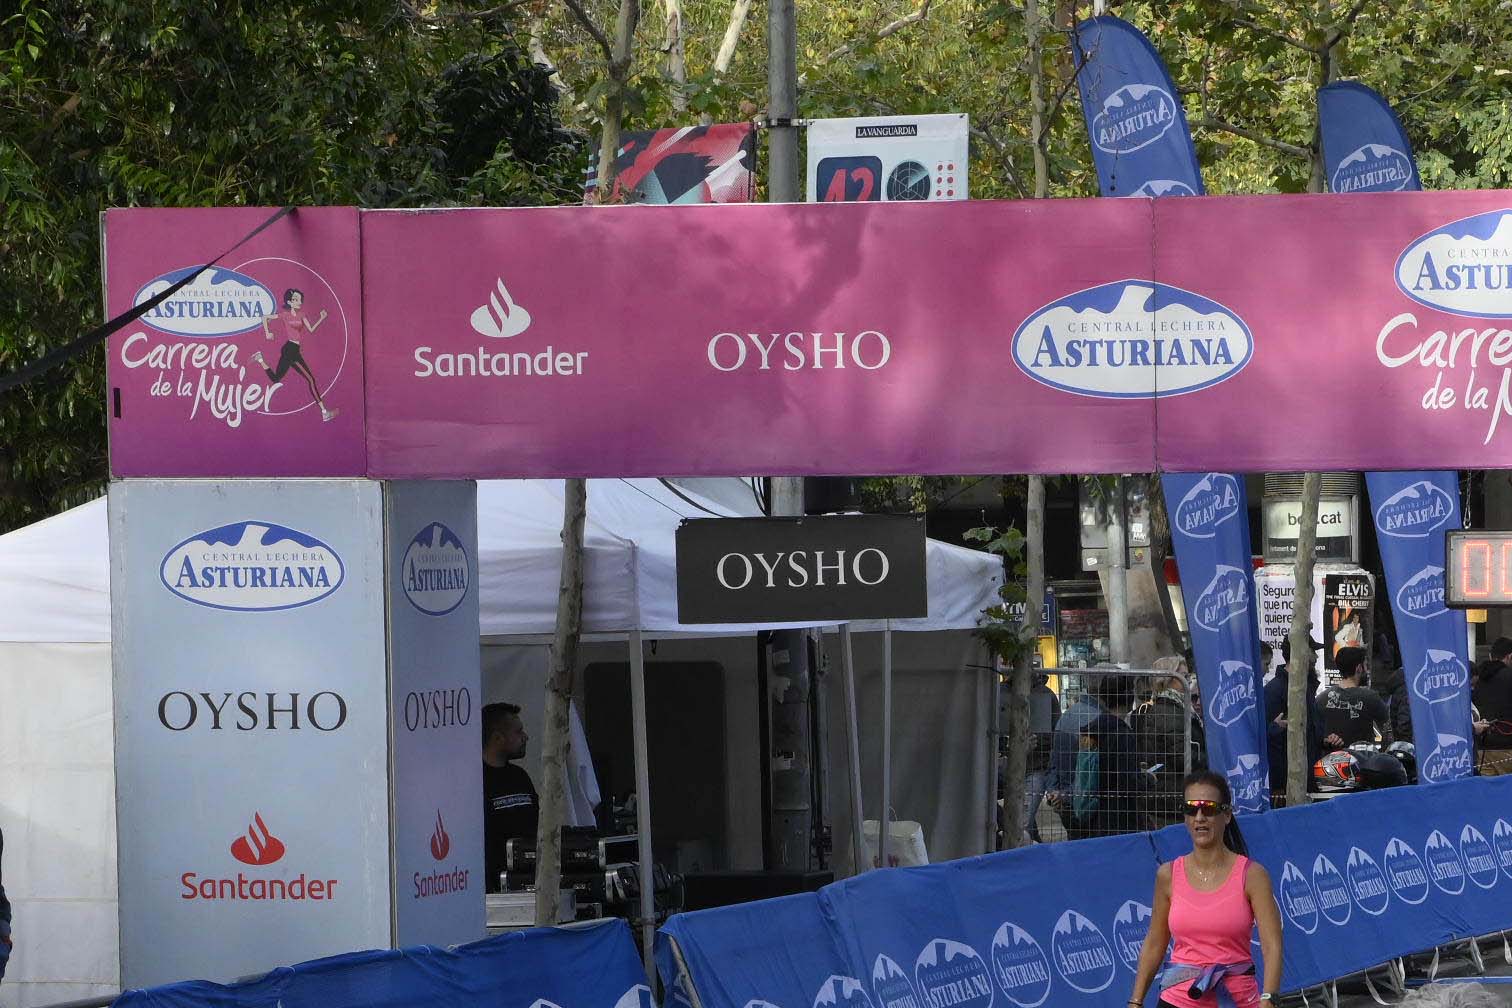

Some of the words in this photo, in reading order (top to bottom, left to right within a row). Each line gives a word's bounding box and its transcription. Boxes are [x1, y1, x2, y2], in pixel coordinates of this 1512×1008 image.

[866, 126, 917, 137] VANGUARDIA
[144, 292, 265, 319] ASTURIANA
[172, 289, 209, 298] ENTRAL
[214, 289, 260, 298] LECHERA
[1068, 321, 1143, 333] CENTRAL
[1151, 320, 1226, 332] LECHERA
[121, 331, 239, 370] Carrera
[413, 346, 589, 378] Santander
[706, 331, 893, 371] OYSHO
[1030, 324, 1235, 368] ASTURIANA
[150, 371, 172, 397] de
[177, 370, 193, 397] la
[190, 366, 284, 428] Mujer
[1421, 371, 1456, 410] de
[1464, 370, 1489, 410] la
[1288, 511, 1342, 526] b.cat
[175, 555, 332, 589] ASTURIANA
[202, 553, 260, 562] CENTRAL
[266, 552, 325, 562] LECHERA
[716, 547, 890, 590] OYSHO
[407, 555, 466, 593] ASTURIANA
[1338, 583, 1370, 596] ELVIS
[1263, 600, 1280, 612] que
[1264, 611, 1295, 624] quiere
[158, 691, 348, 732] OYSHO
[404, 687, 471, 733] OYSHO
[180, 871, 338, 900] Santander
[413, 865, 470, 900] Santander
[996, 957, 1049, 990] ASTURIANA
[1058, 944, 1113, 976] ASTURIANA
